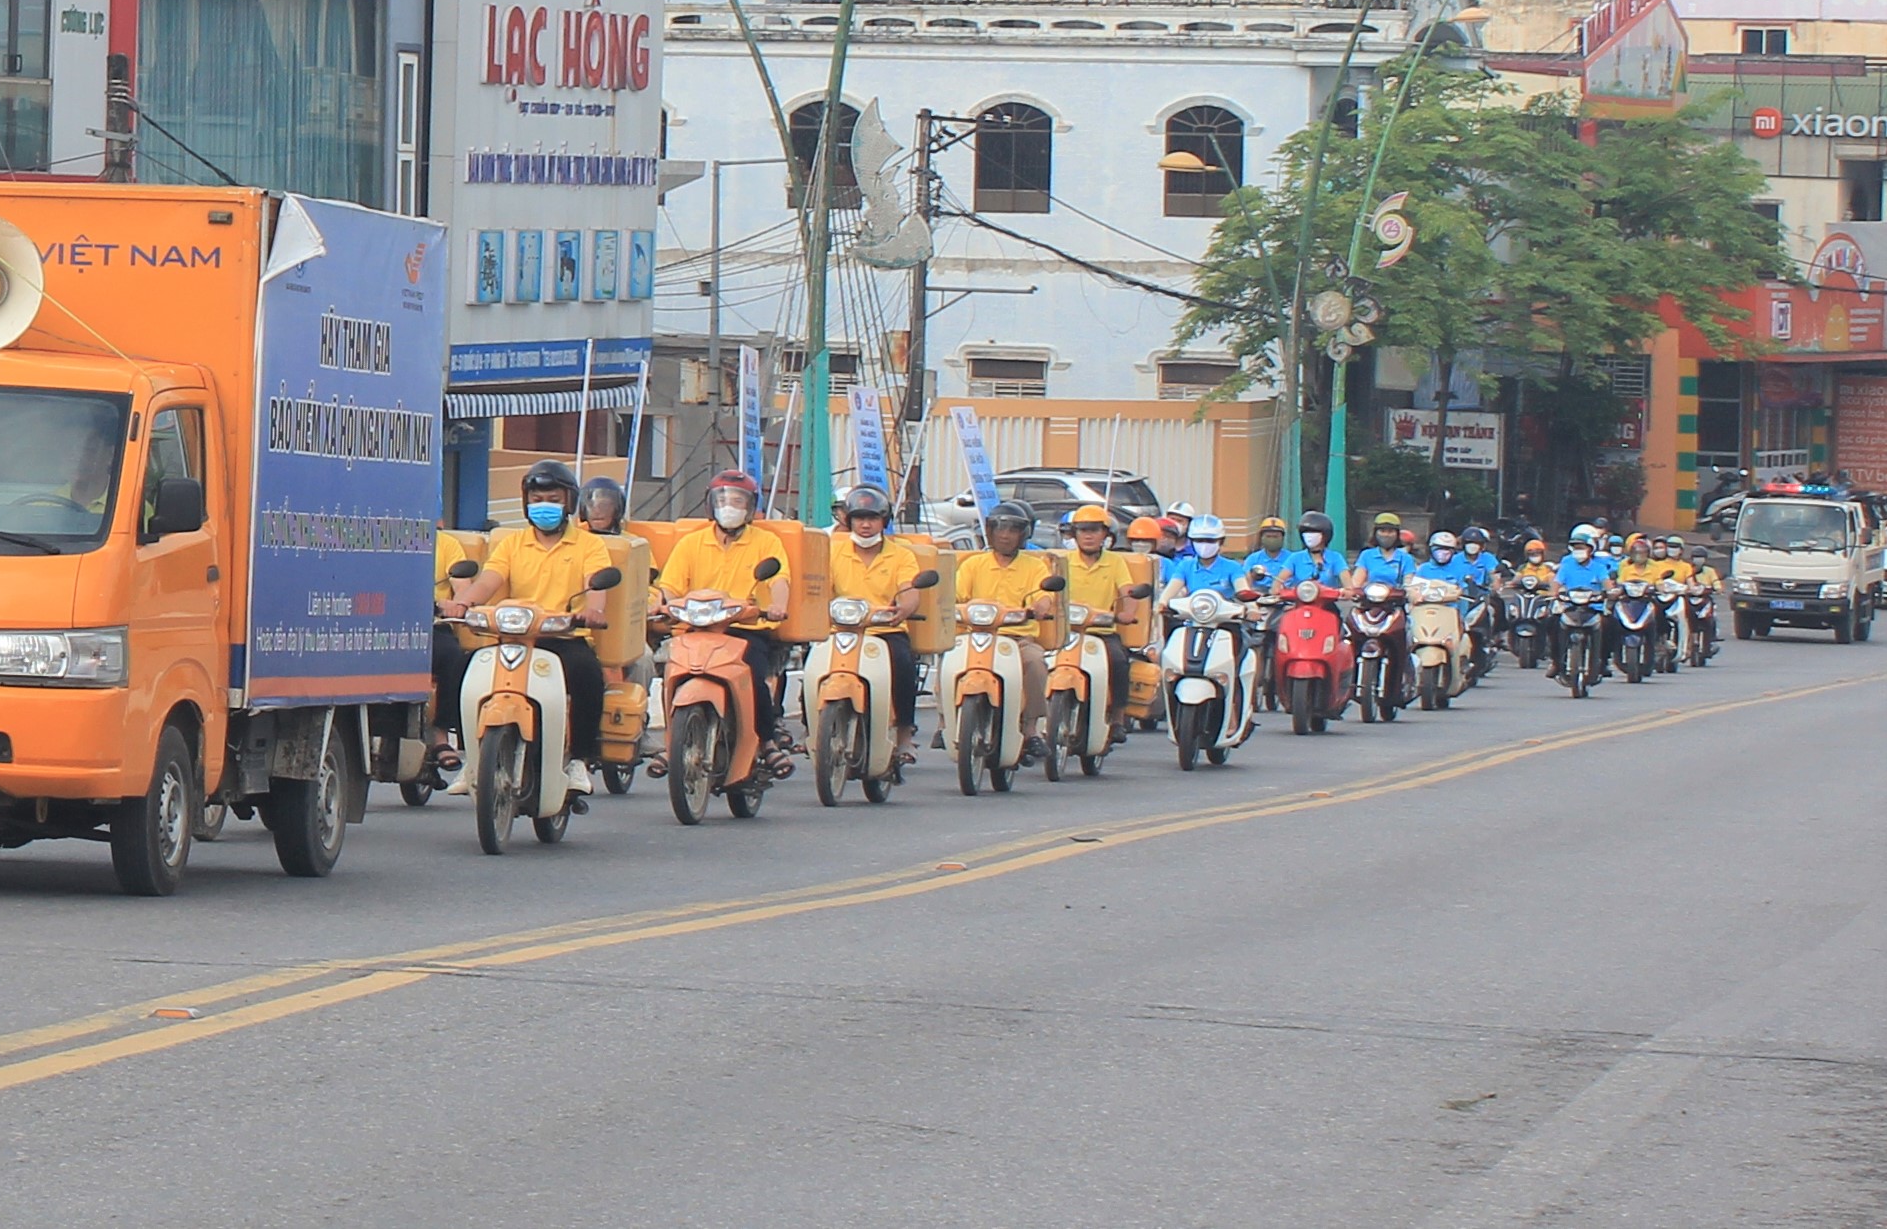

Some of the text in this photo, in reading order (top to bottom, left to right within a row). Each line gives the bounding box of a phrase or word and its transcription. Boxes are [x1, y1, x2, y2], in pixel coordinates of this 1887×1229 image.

[481, 2, 548, 103] LẠC
[35, 234, 119, 273] VIỆT
[130, 245, 222, 269] NAM
[320, 304, 342, 370] HÃY
[343, 316, 373, 374] THAM
[373, 321, 392, 376] GIA
[268, 379, 434, 472] BẢO HIỂM XÃ HỘI NGAY HÔM NAY
